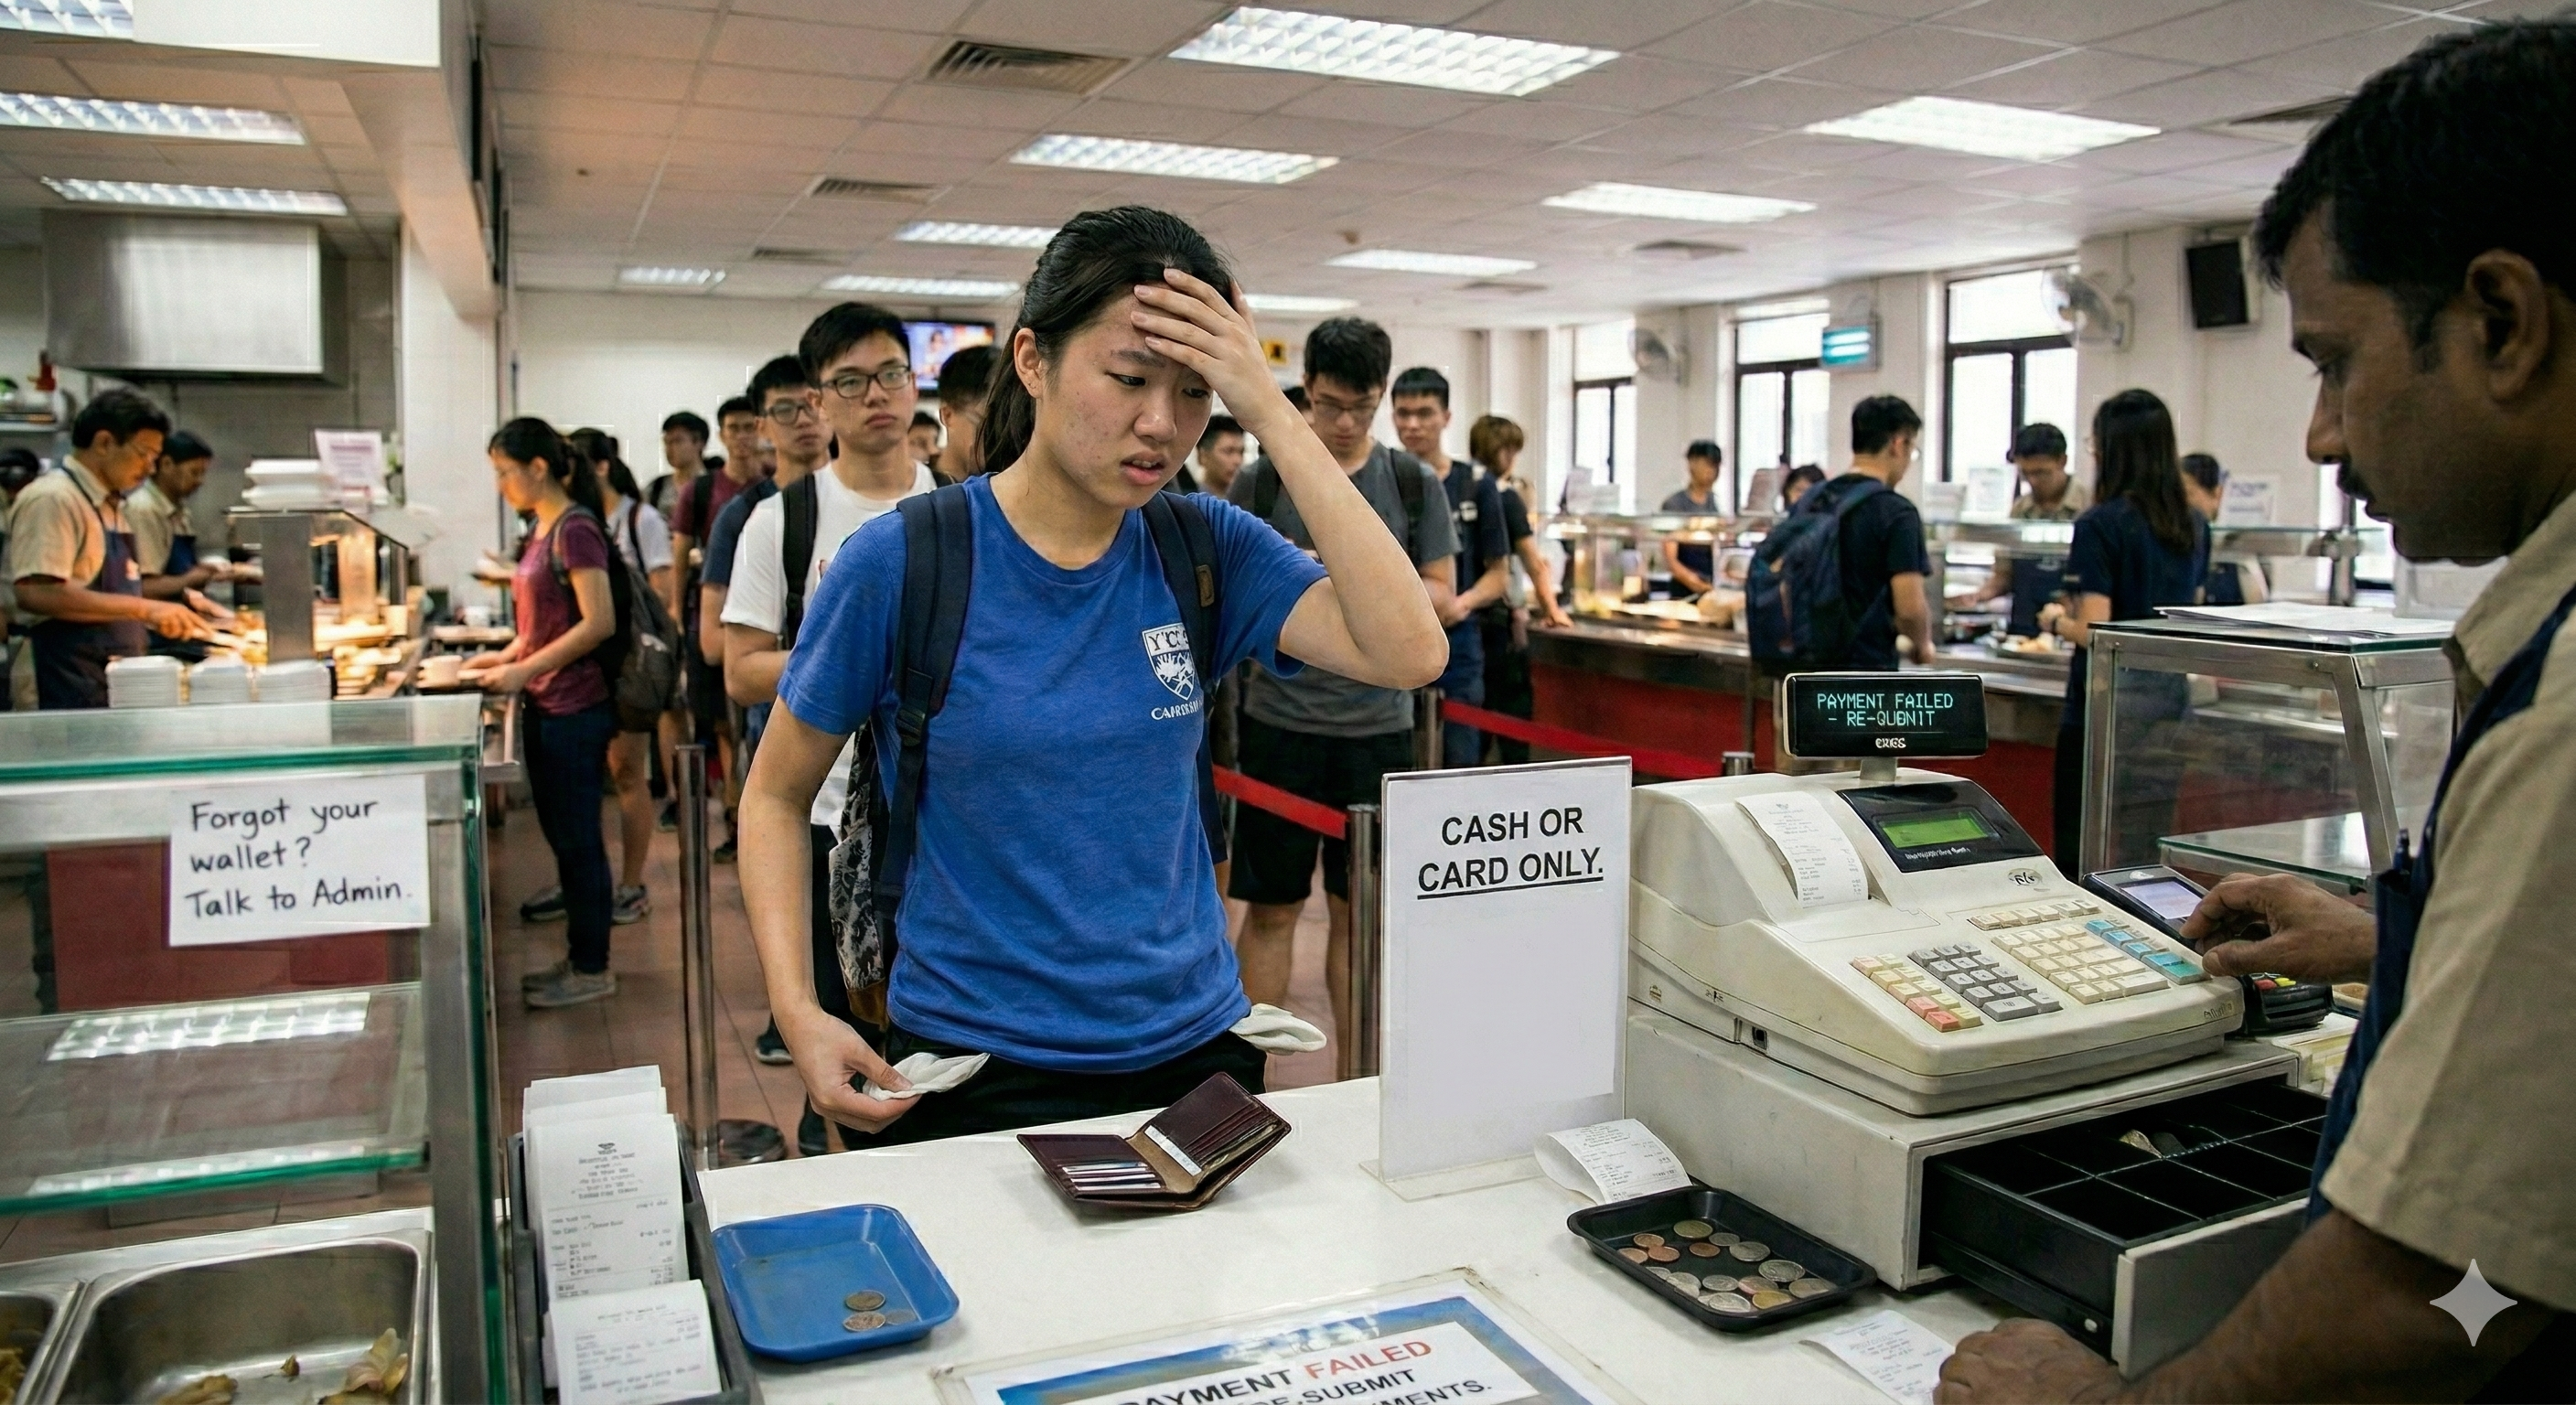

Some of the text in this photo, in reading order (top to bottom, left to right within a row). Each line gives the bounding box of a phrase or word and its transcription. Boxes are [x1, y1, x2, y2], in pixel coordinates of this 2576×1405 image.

[1817, 692, 1954, 710] PAYMENT FAILED
[191, 799, 378, 840] Forgot your
[1442, 807, 1583, 846] CASH OR
[1418, 847, 1604, 892] CARD ONLY.
[186, 876, 412, 918] Talk to Admin.
[1118, 1341, 1432, 1405] YMENT FAILED
